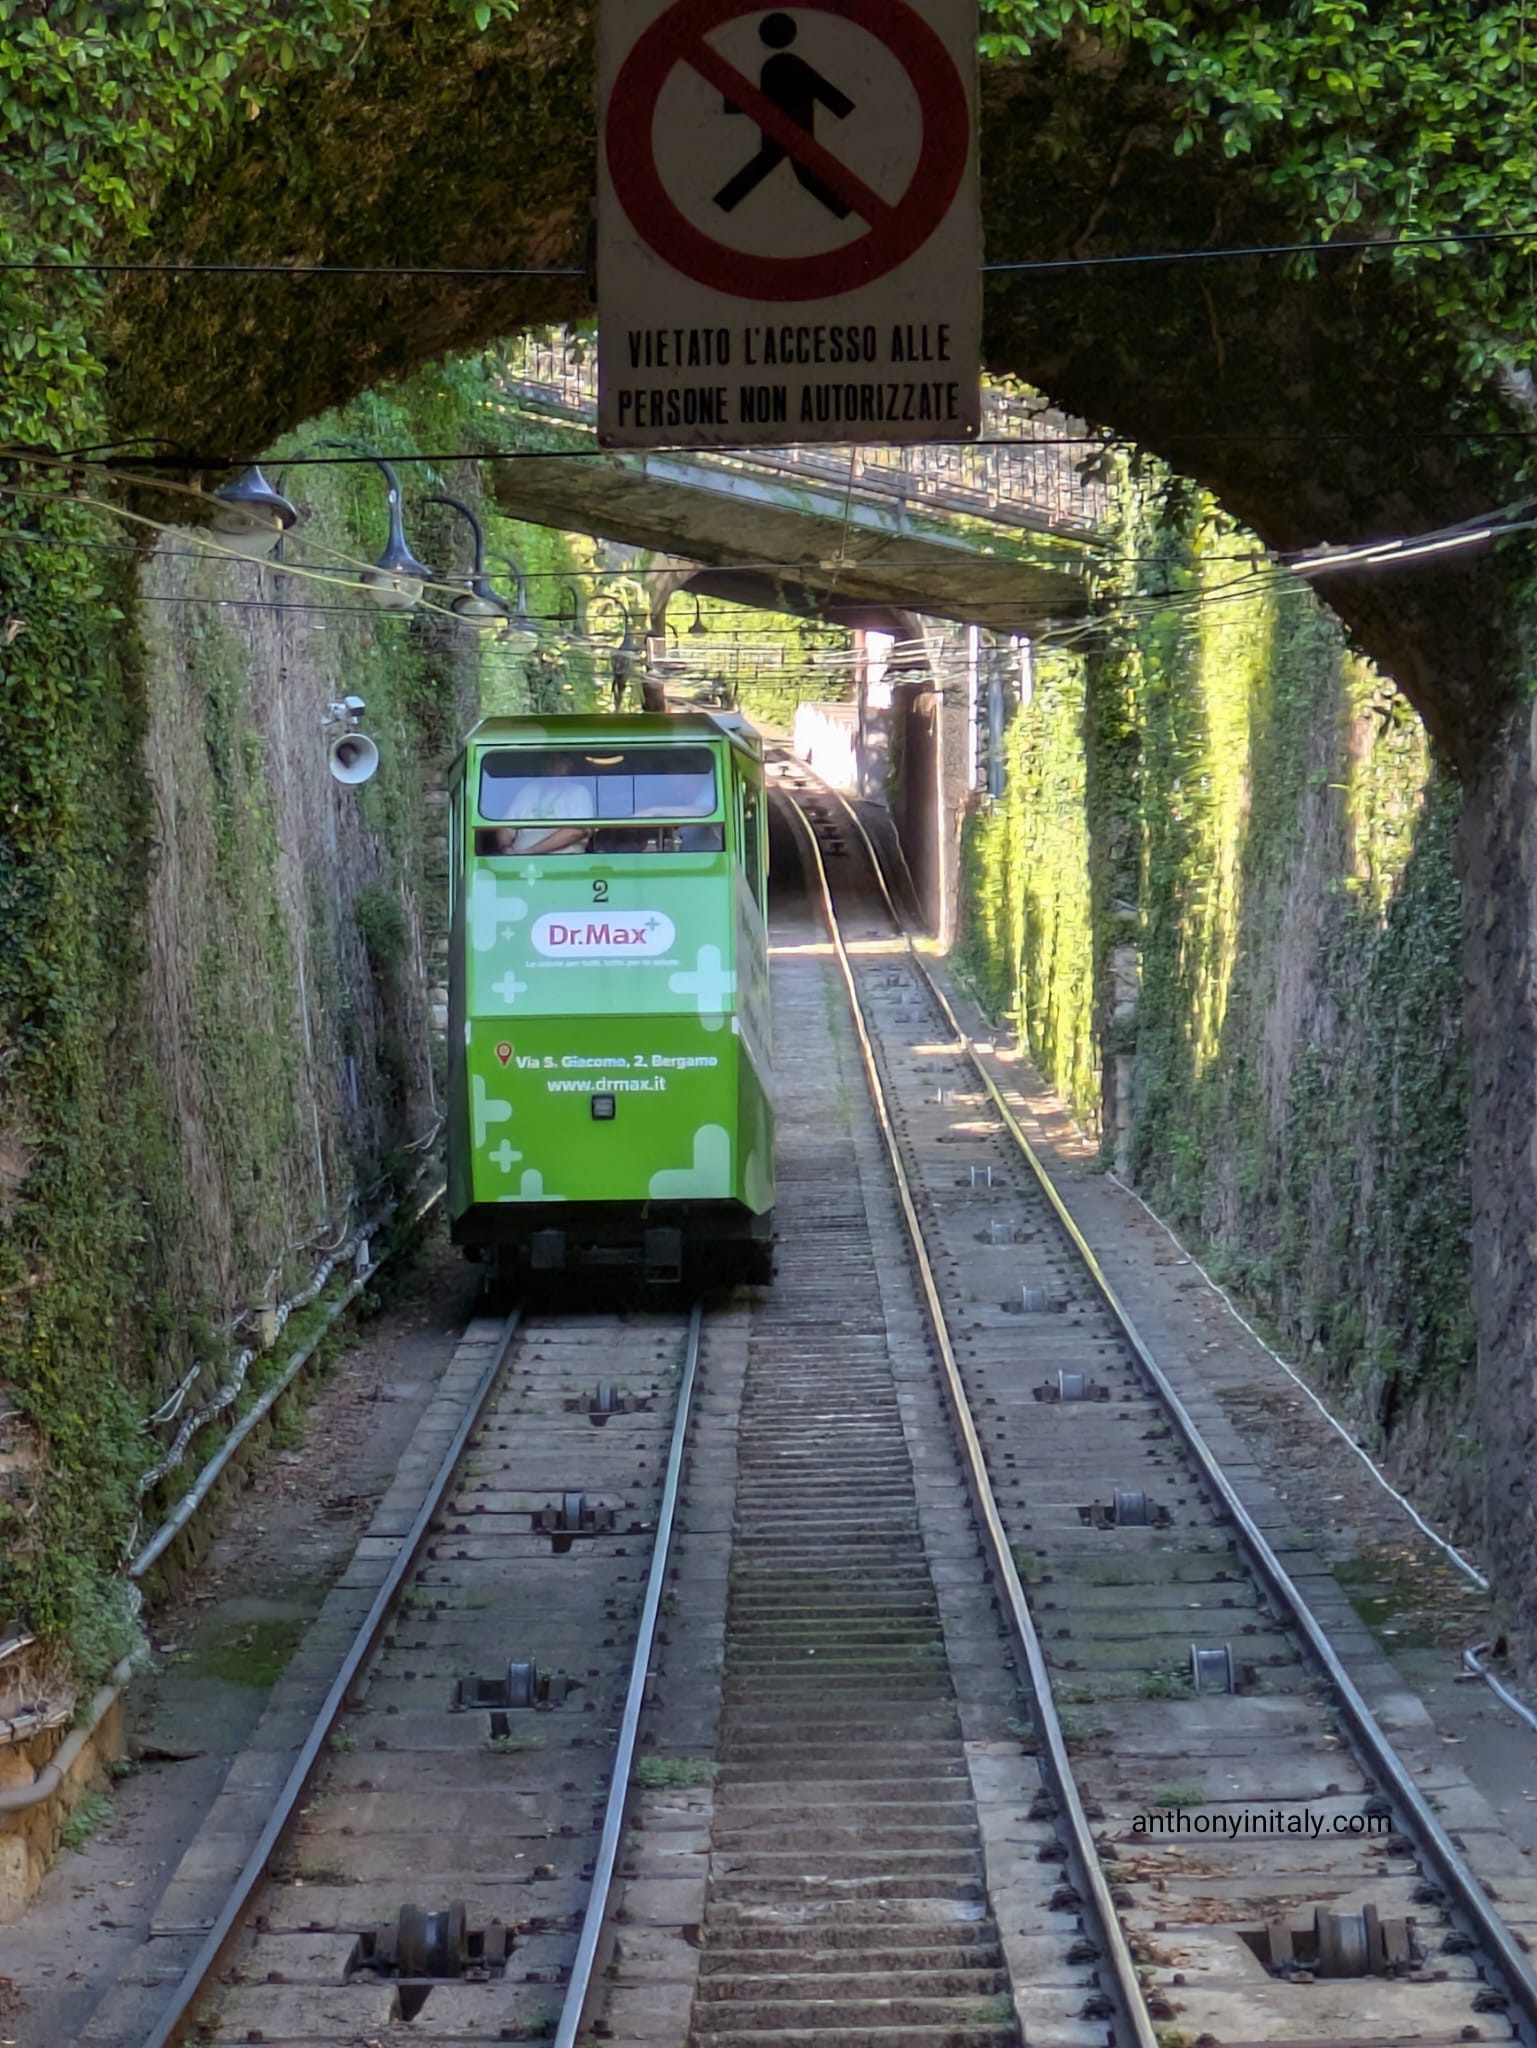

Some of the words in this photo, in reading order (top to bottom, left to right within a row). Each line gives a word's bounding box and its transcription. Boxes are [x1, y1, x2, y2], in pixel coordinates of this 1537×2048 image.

[628, 330, 730, 368] VIETATO
[744, 326, 876, 365] L'ACCESSO
[891, 324, 951, 362] ALLE
[618, 387, 728, 427] PERSONE
[740, 385, 788, 424] NON
[801, 383, 959, 422] AUTORIZZATE
[592, 880, 609, 903] 2
[549, 923, 647, 945] Dr.Max
[516, 1055, 540, 1069] Via
[651, 1054, 718, 1070] Bergamo
[547, 1076, 666, 1092] www.drmax.it
